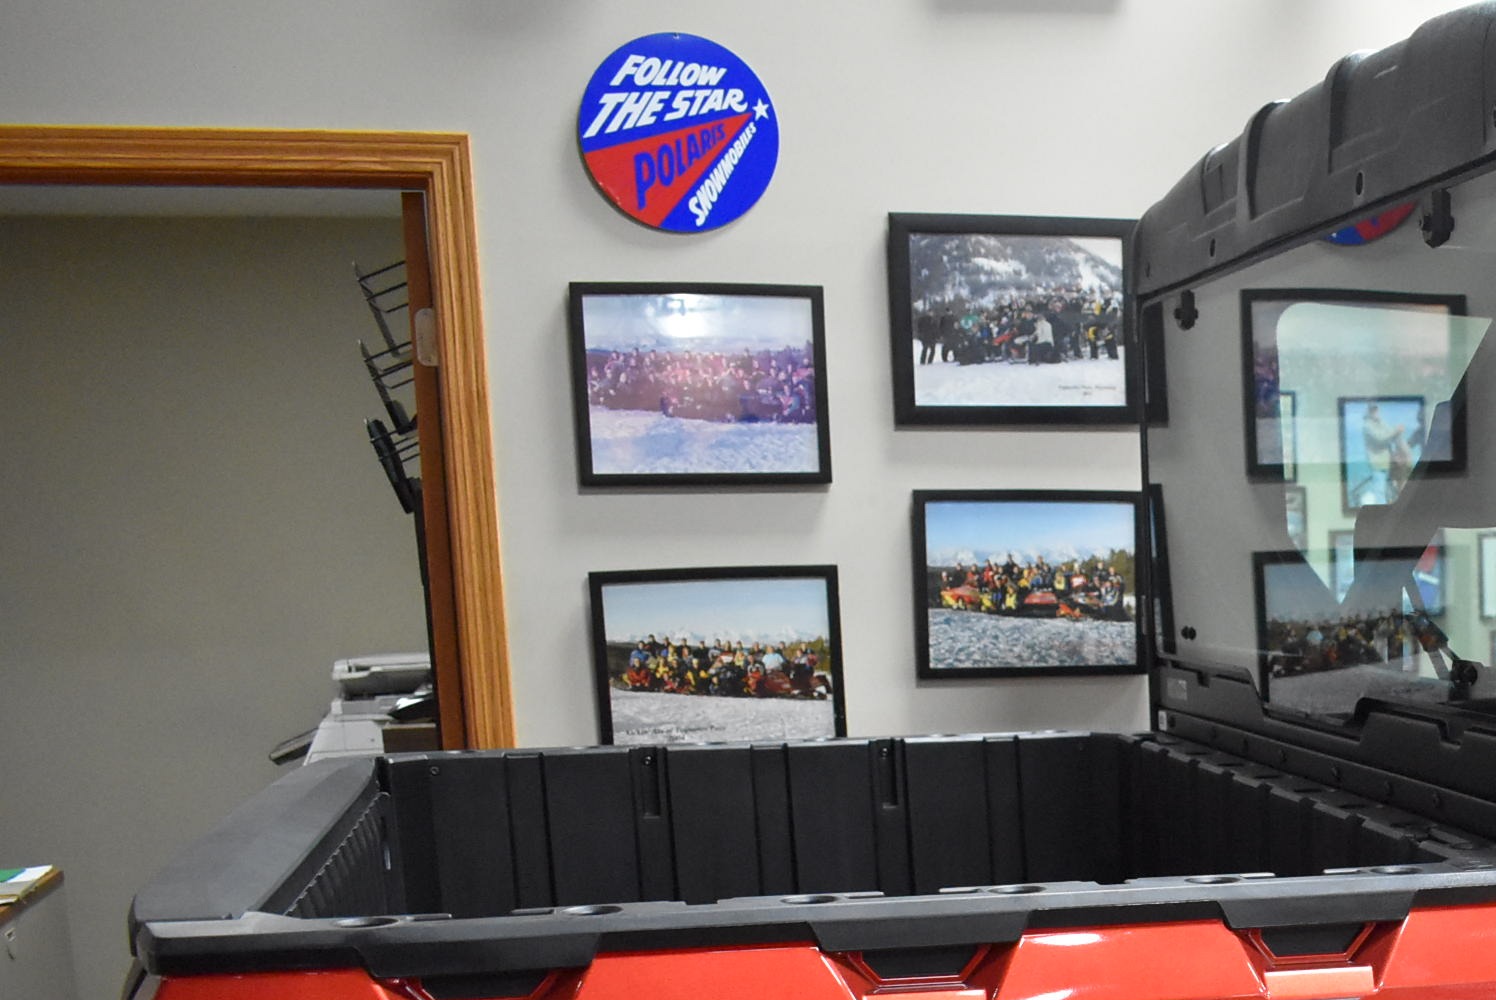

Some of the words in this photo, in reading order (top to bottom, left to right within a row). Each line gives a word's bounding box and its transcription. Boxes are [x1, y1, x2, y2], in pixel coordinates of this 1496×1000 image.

[609, 54, 727, 87] FOLLOW
[583, 90, 671, 139] THE
[663, 88, 748, 122] STAR
[633, 123, 727, 212] POLARIS
[688, 121, 757, 227] SNOWMOBILES
